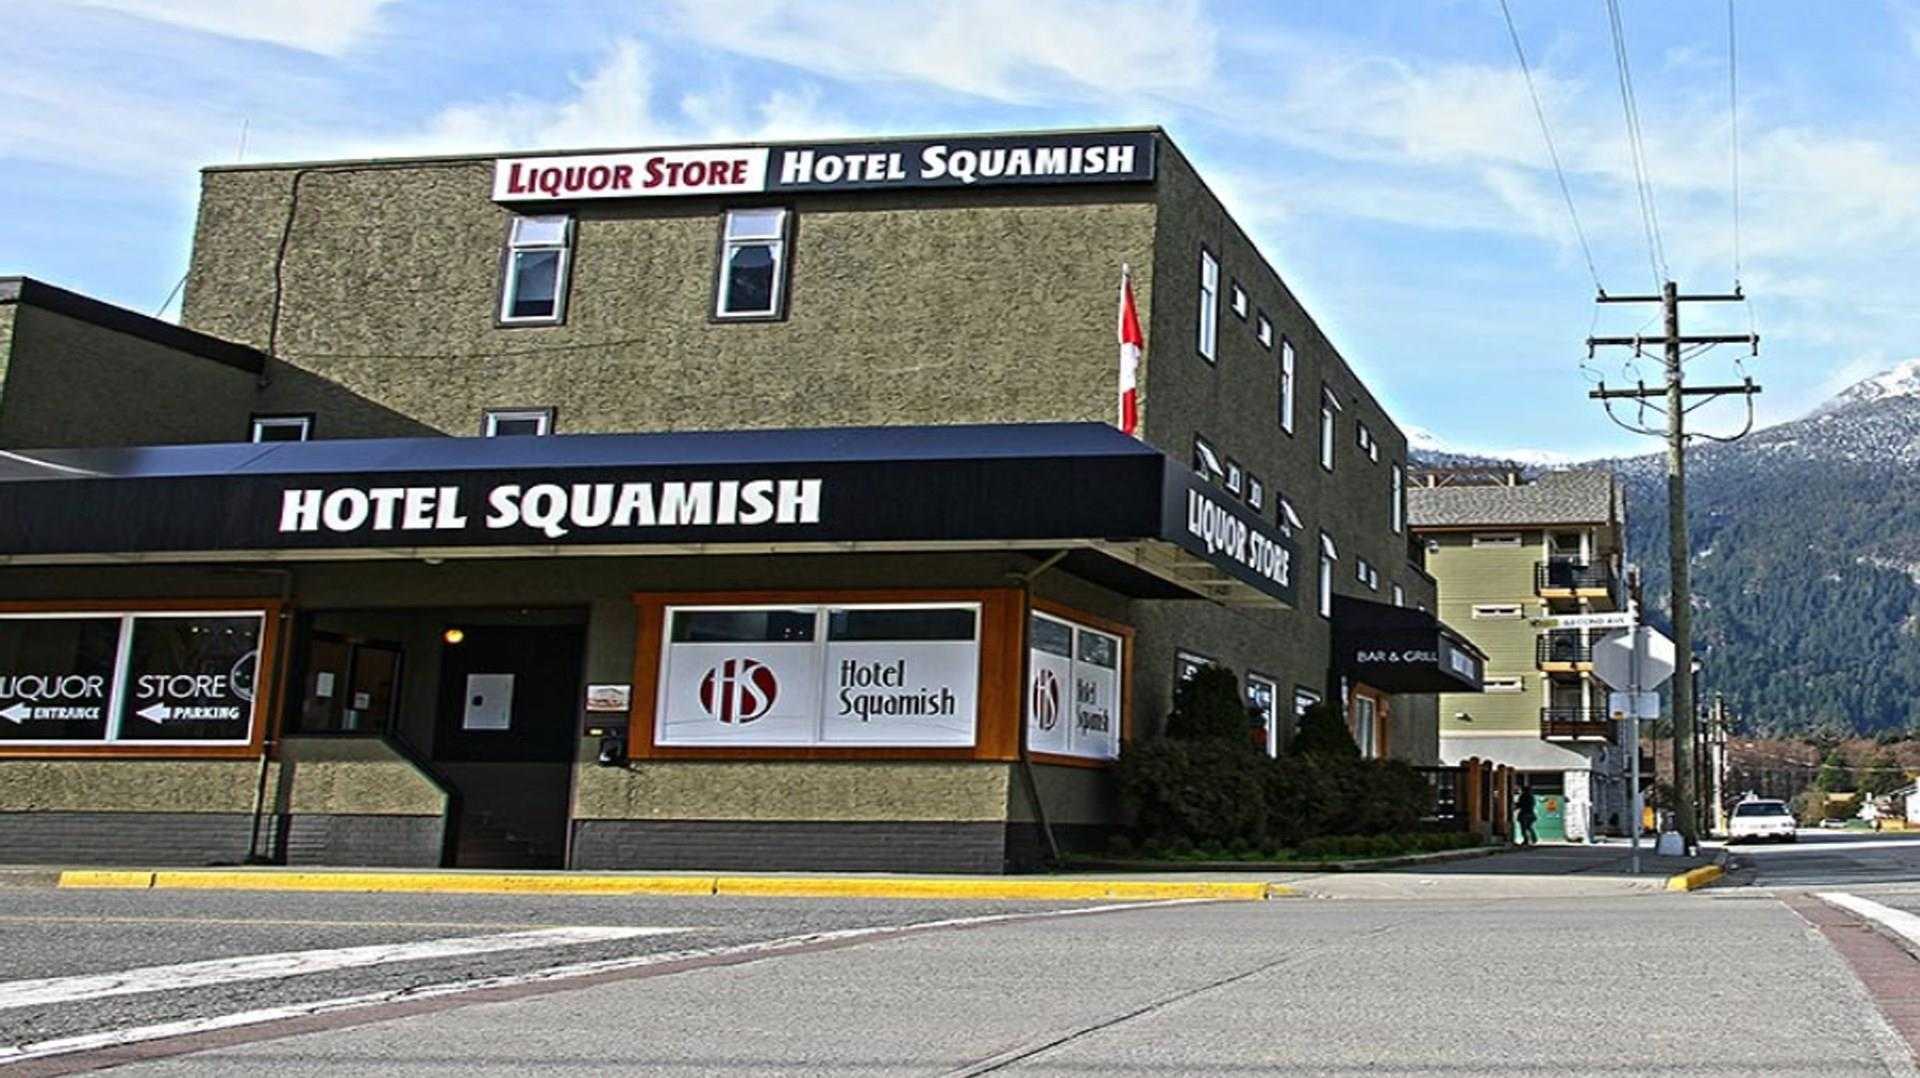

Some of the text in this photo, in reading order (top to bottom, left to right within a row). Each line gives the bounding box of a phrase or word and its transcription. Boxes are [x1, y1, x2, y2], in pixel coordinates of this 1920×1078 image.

[507, 157, 748, 197] LIQUOR STORE
[781, 145, 1136, 184] HOTEL SQUAMISH
[279, 479, 822, 538] HOTEL SQUAMISH
[1188, 488, 1290, 588] LIQUOR STORE
[1357, 651, 1385, 662] BAR
[1388, 651, 1399, 661] &
[0, 674, 227, 701] LIQUOR STORE
[840, 659, 905, 688] Hotel
[33, 706, 100, 720] ENTRANCE
[172, 706, 241, 720] PARKING
[838, 687, 956, 722] Squamish
